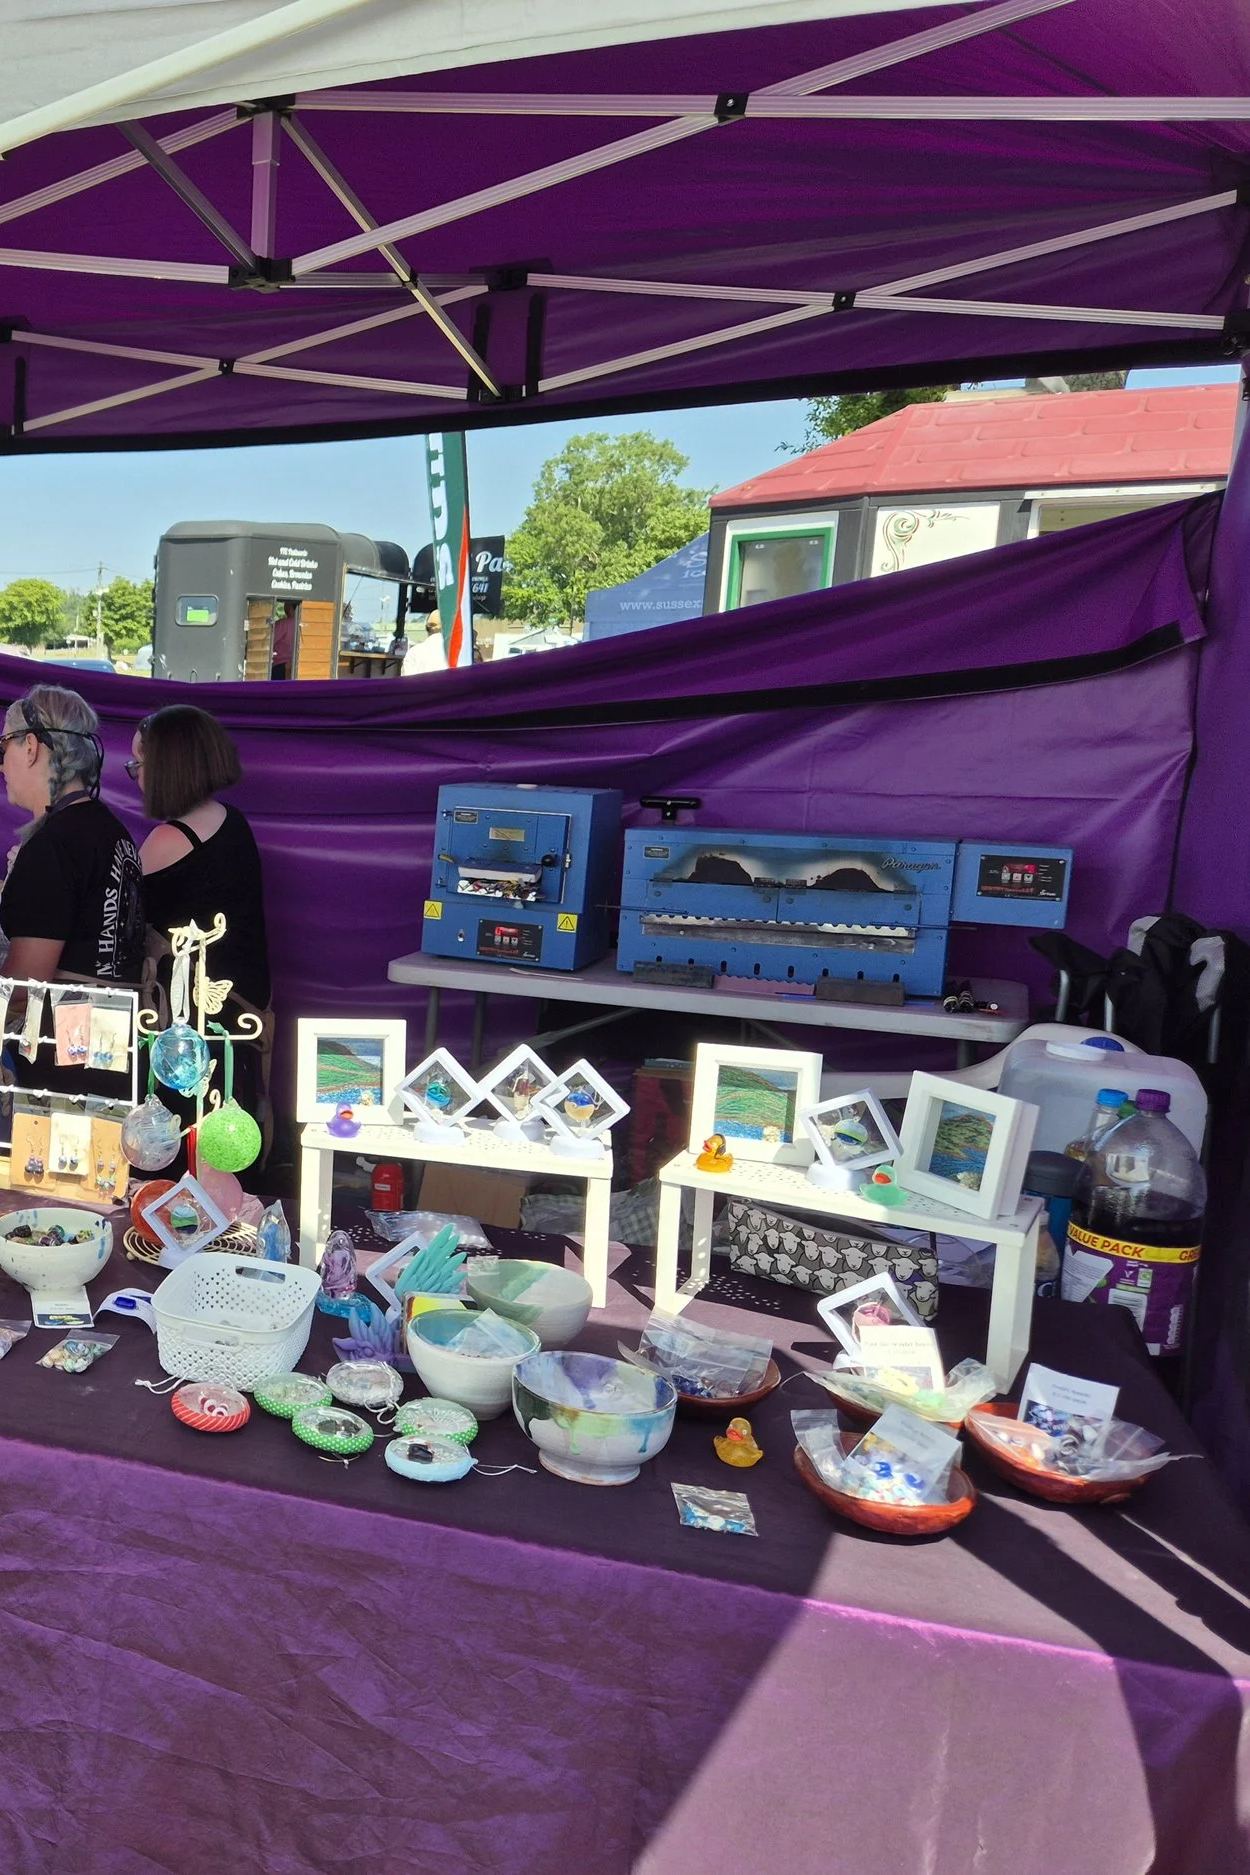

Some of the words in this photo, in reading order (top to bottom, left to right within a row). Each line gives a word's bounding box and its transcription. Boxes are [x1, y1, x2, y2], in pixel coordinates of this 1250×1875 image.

[278, 558, 289, 567] and
[289, 558, 300, 567] Cold
[471, 582, 489, 593] 641
[881, 856, 941, 873] Paragon
[99, 887, 118, 953] HANDS
[1068, 1224, 1099, 1247] VALUE
[1100, 1239, 1146, 1259] PACK
